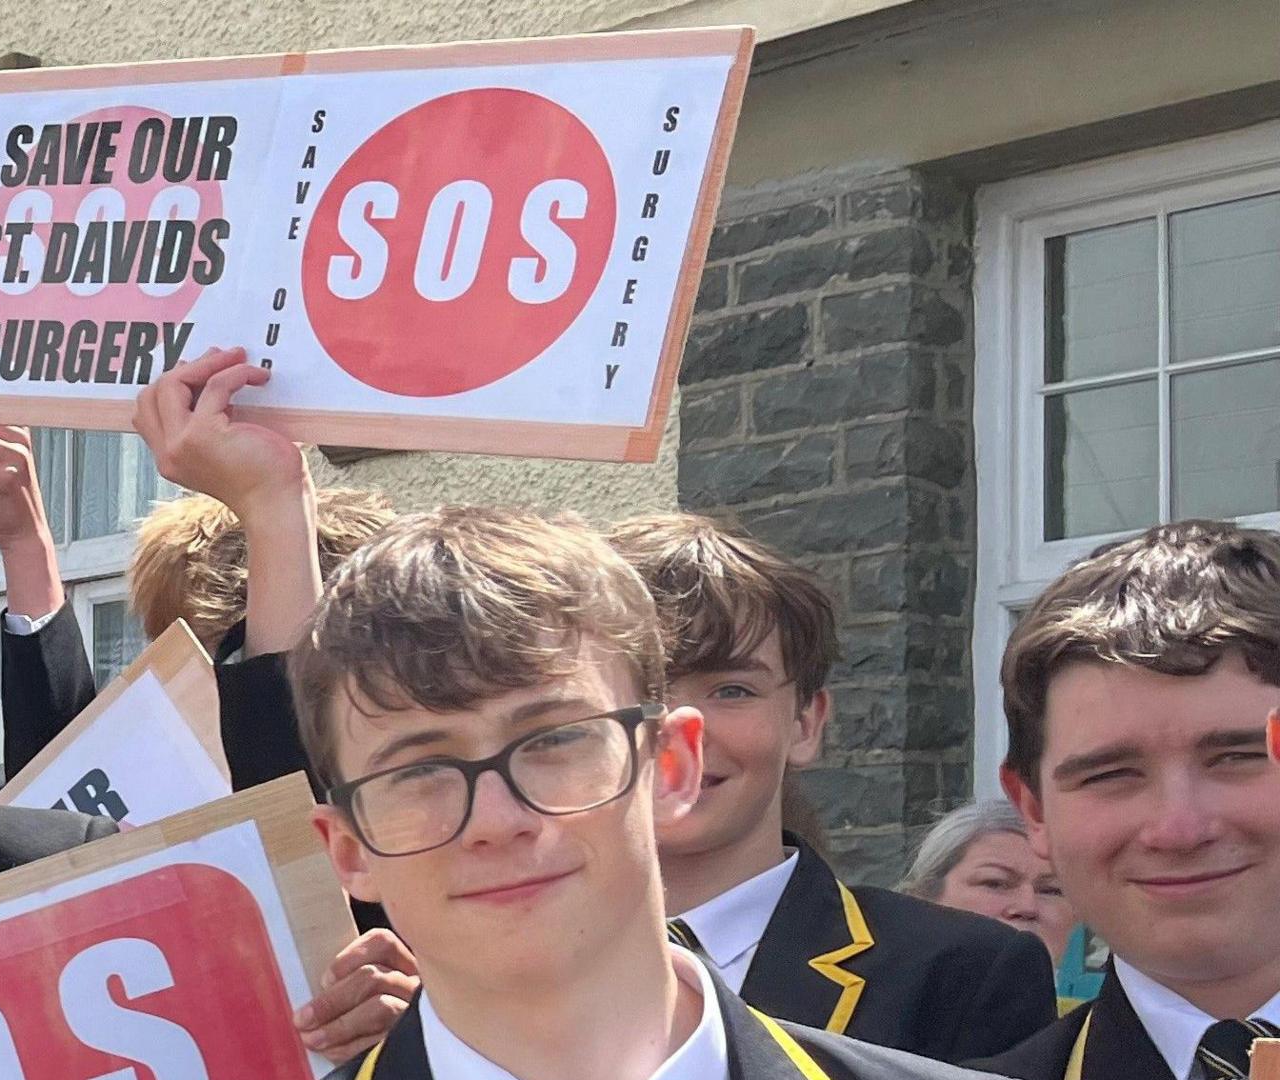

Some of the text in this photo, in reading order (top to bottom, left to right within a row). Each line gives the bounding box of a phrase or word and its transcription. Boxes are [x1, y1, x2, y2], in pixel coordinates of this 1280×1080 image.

[0, 115, 238, 184] SAVE OUR
[288, 110, 327, 240] SAVE
[41, 218, 231, 286] DAVIDS
[326, 179, 589, 304] SOS
[604, 106, 680, 390] SURGERY
